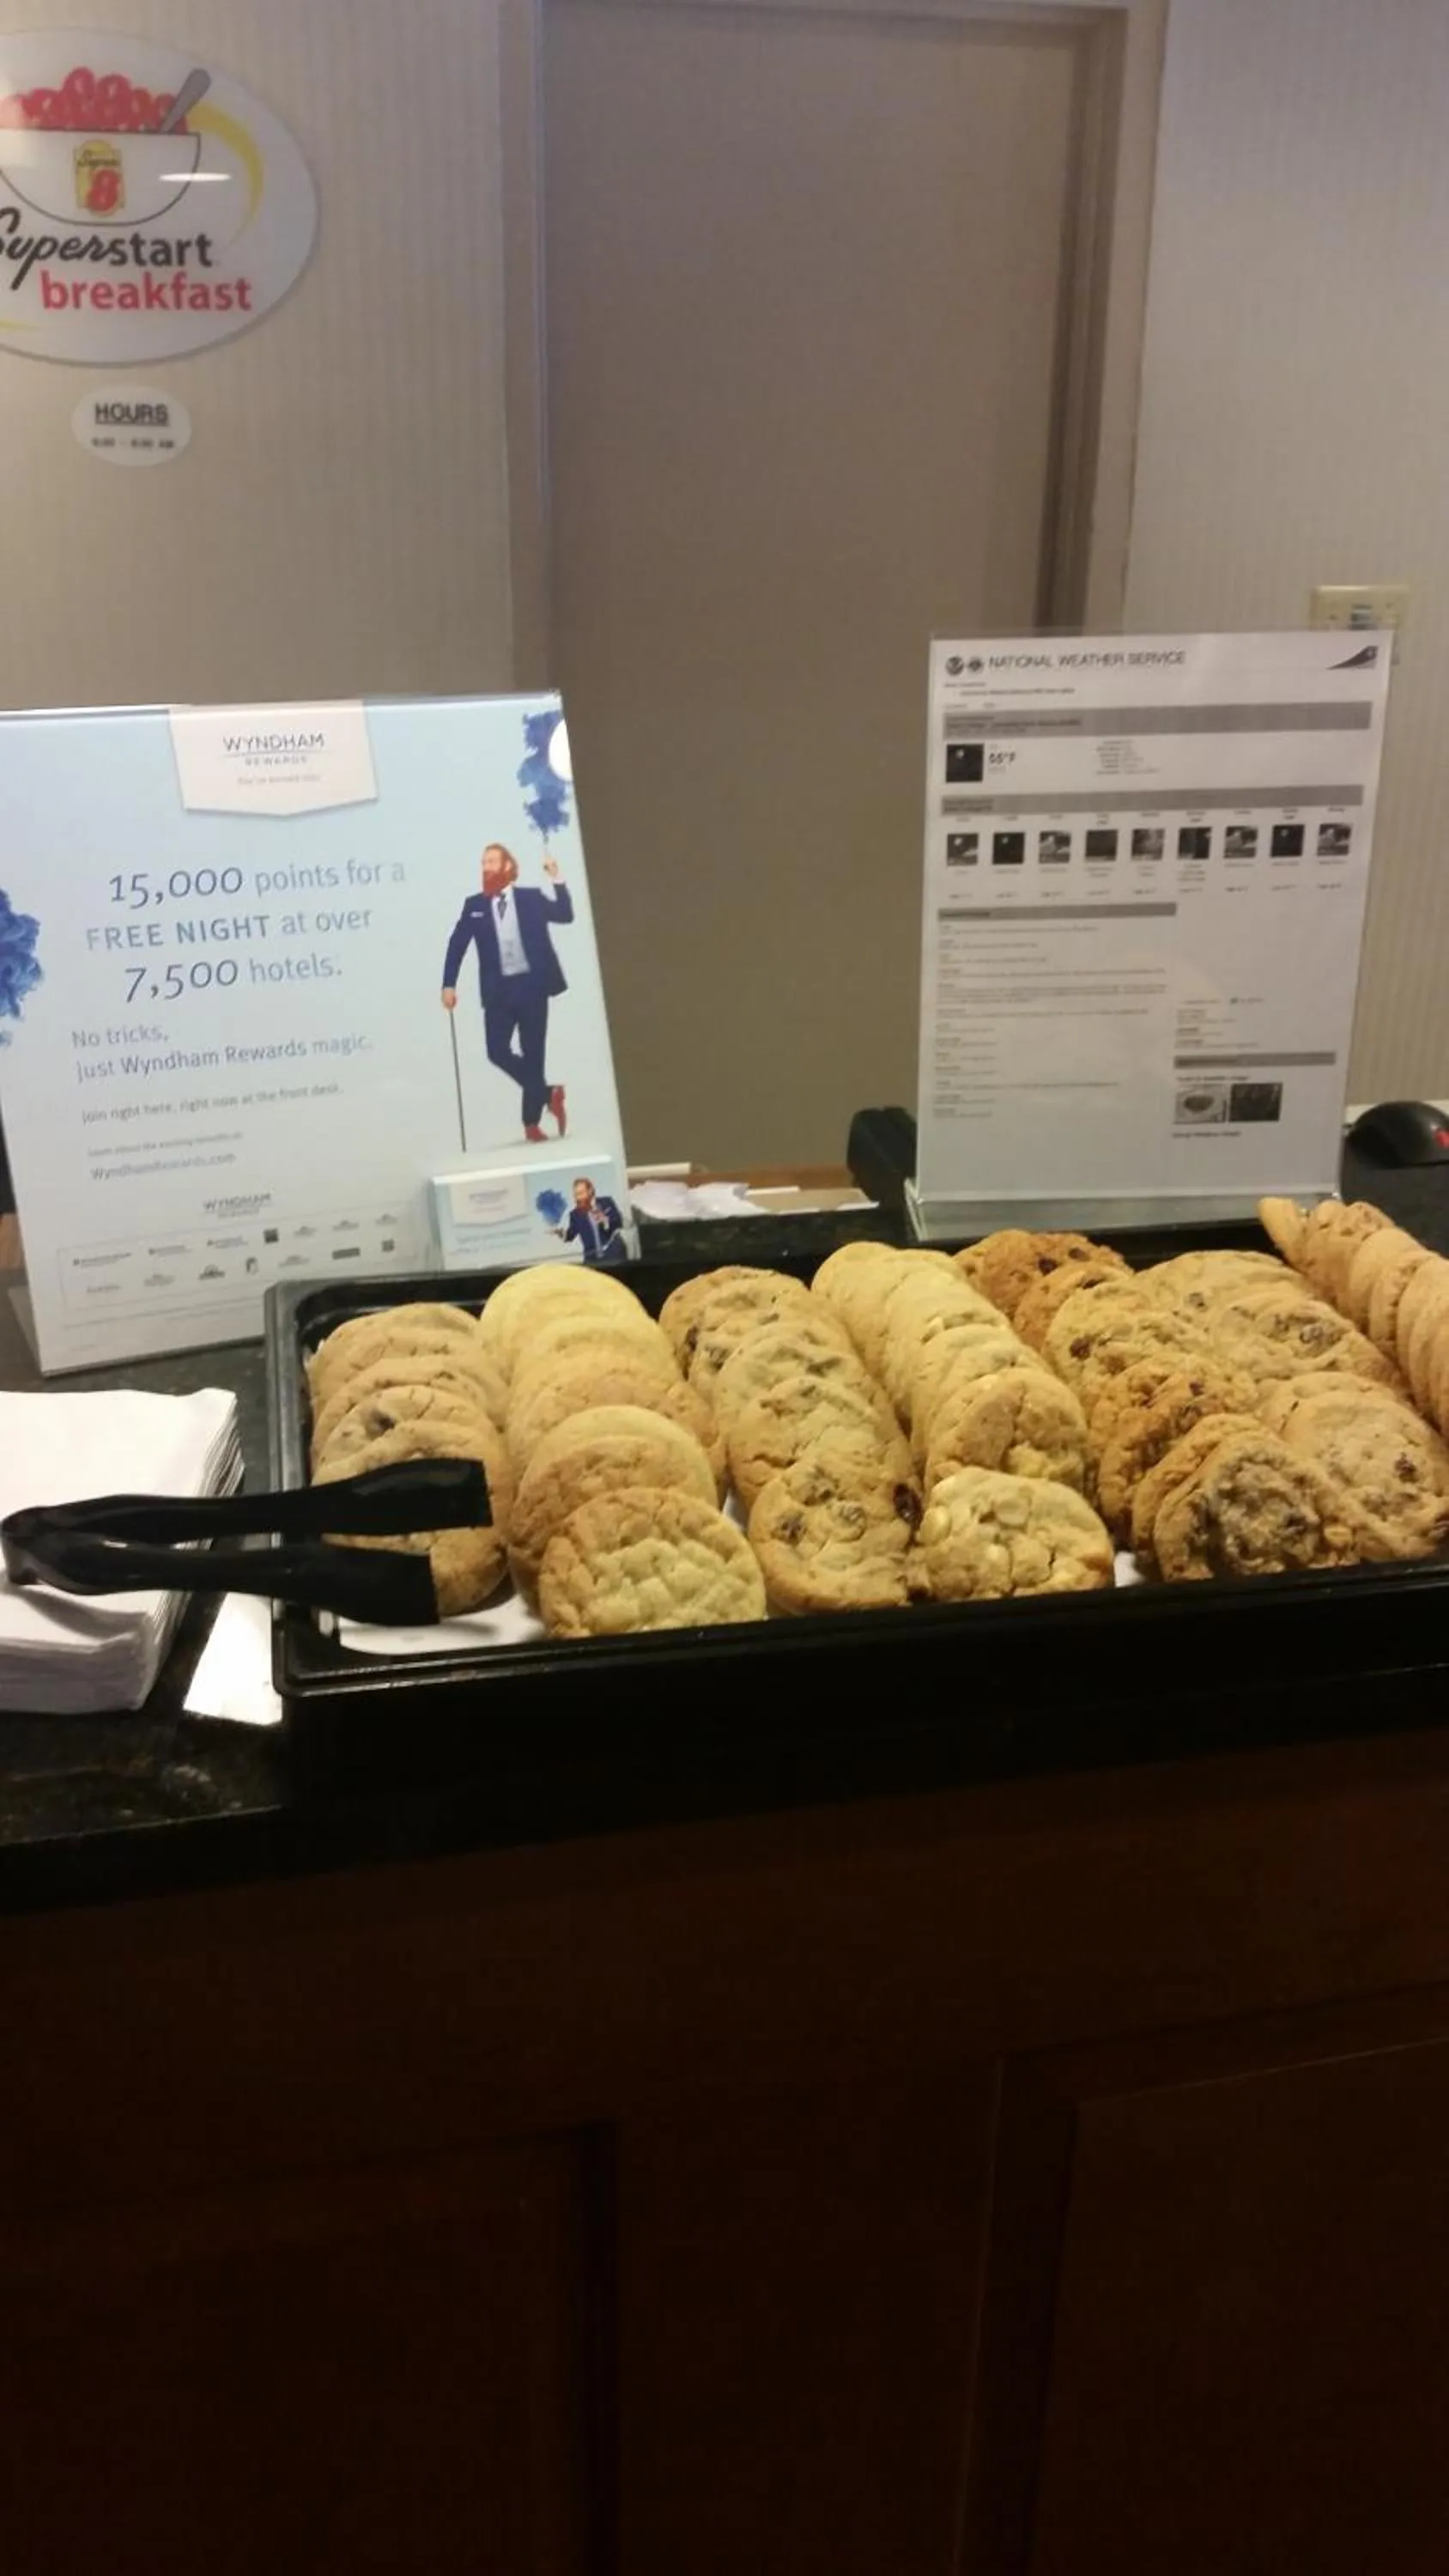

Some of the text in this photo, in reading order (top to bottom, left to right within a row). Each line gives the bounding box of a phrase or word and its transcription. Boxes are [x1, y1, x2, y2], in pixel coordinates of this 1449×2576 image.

[39, 269, 252, 310] breakfast
[94, 402, 169, 426] HOURS
[988, 650, 1185, 668] NATIONAL WEATHER SERVICE
[222, 732, 325, 752] WYNDHAM
[108, 858, 406, 910] 15,000 points for a
[86, 908, 373, 951] FREE NIGHT at over
[124, 953, 343, 1004] 7,500 hotels.
[71, 1024, 169, 1048] No tricks,
[120, 1050, 220, 1079] Wyndham
[225, 1037, 308, 1064] Rewards
[111, 1104, 140, 1122] right
[179, 1098, 209, 1114] right
